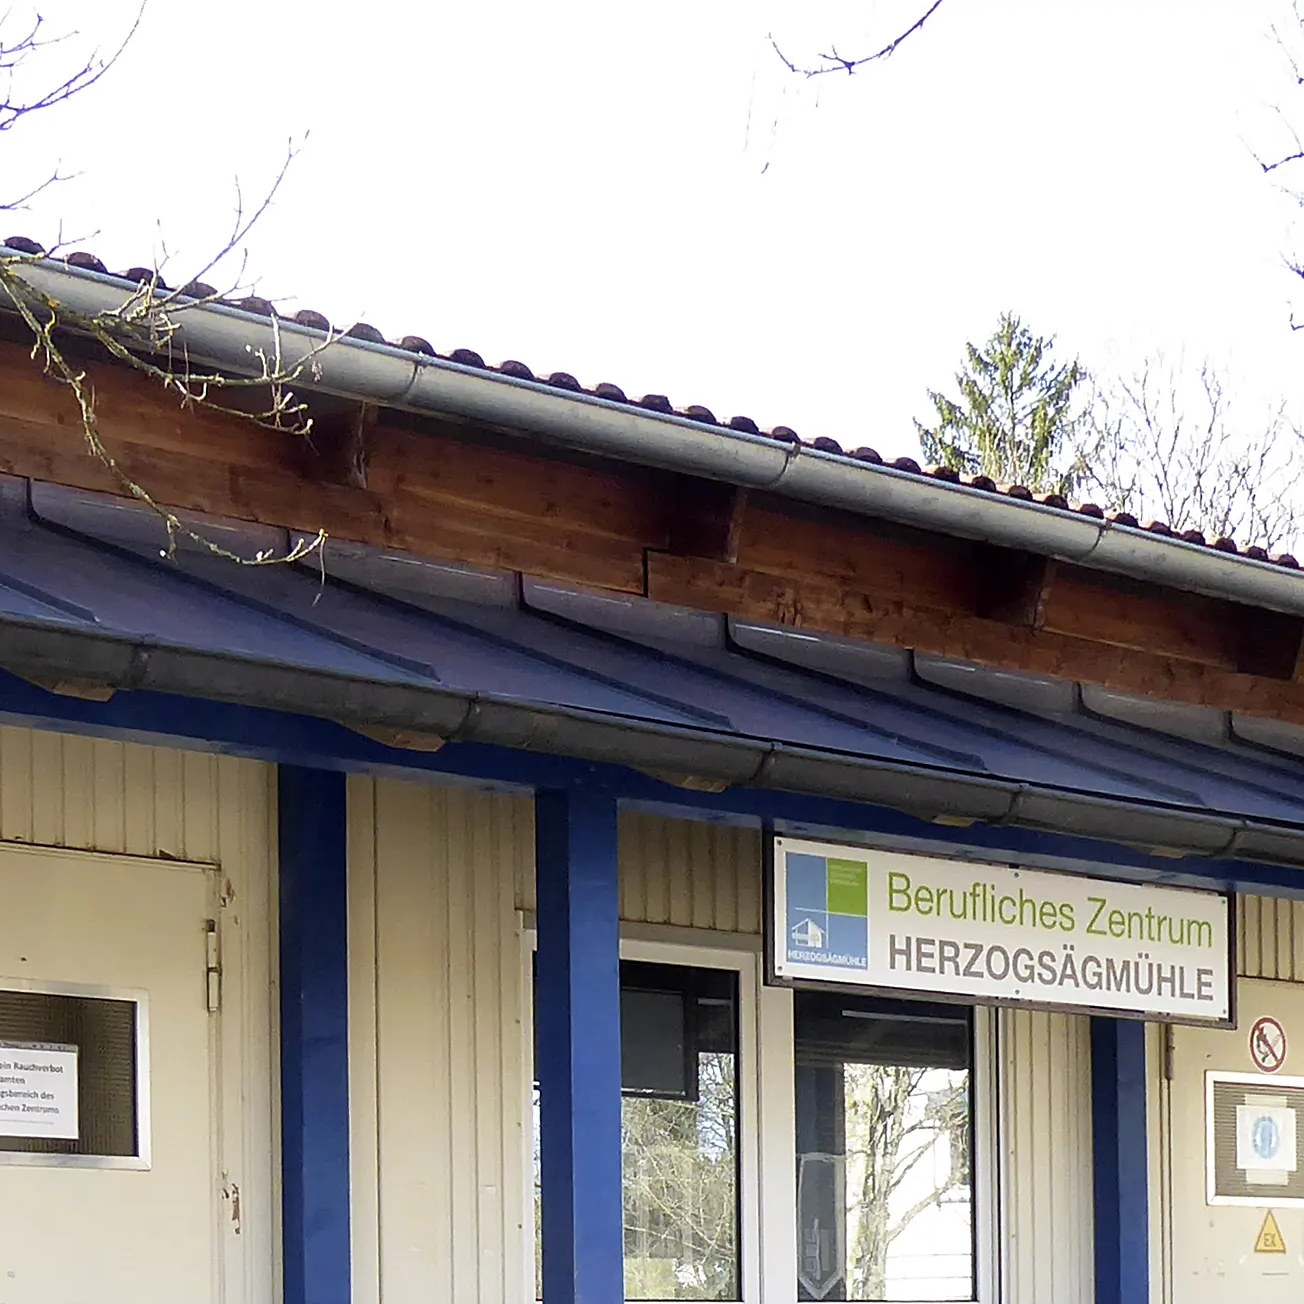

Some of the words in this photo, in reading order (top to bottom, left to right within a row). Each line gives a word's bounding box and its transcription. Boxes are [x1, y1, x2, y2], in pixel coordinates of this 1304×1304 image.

[887, 870, 1076, 932] Berufliches
[1086, 896, 1213, 948] Zentrum
[888, 933, 1215, 1001] HERZOGSÄGMÜHLE
[13, 1061, 64, 1074] Rauchverbot
[40, 1090, 55, 1100] des
[21, 1103, 60, 1114] Zentrums
